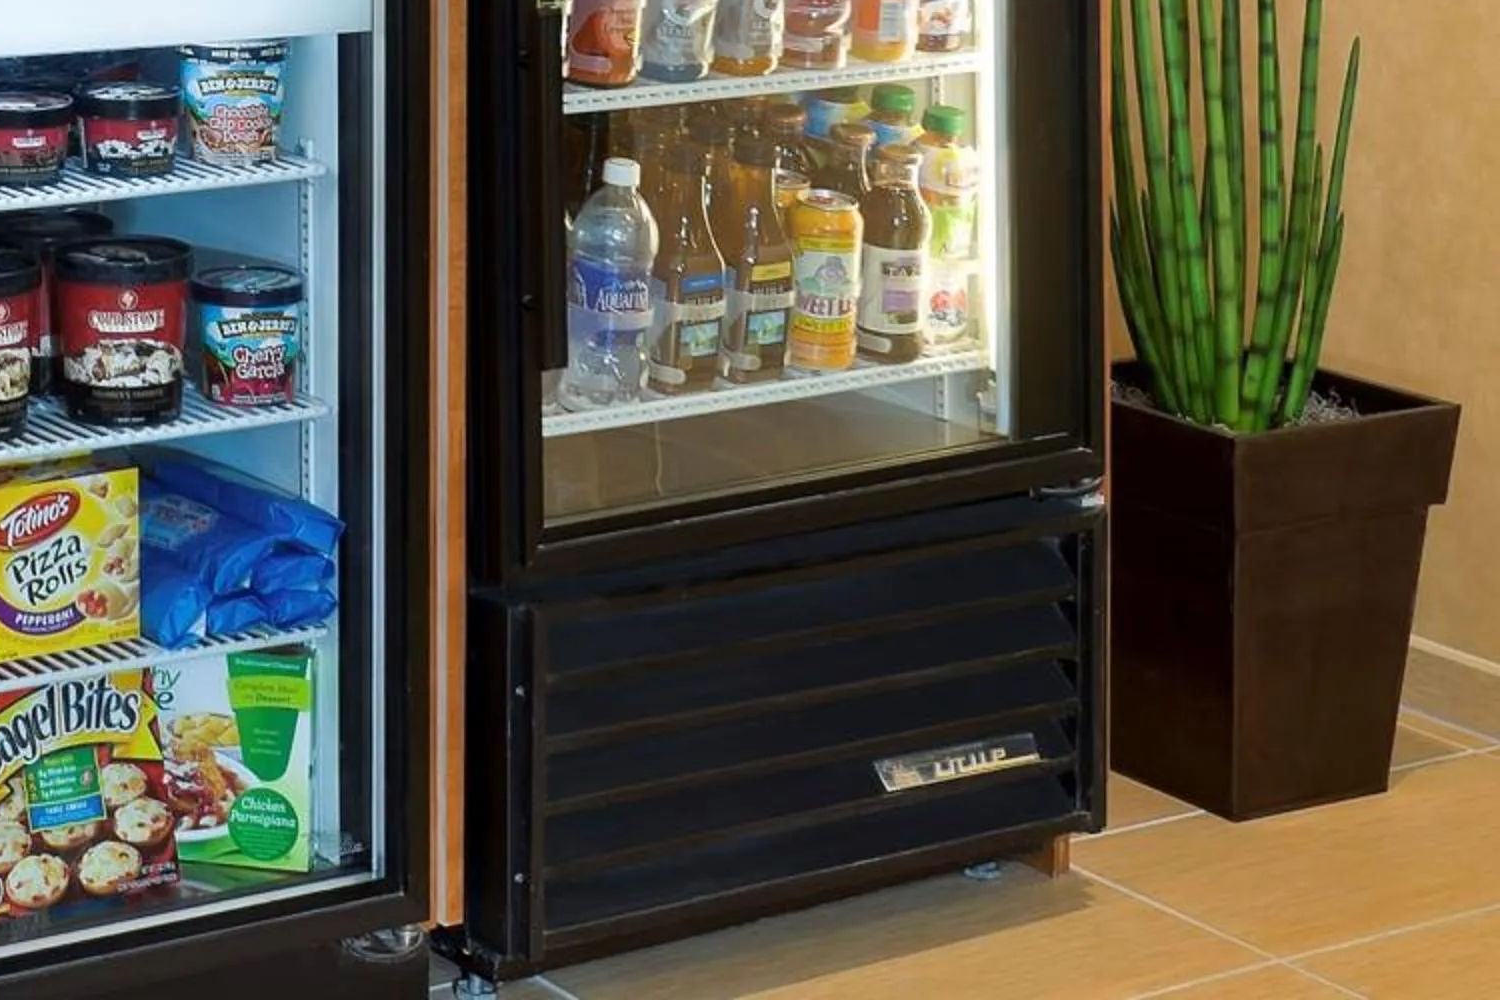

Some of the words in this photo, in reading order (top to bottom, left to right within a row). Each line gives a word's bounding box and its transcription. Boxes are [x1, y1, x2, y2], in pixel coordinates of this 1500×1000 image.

[233, 345, 286, 363] Cherry
[235, 362, 285, 380] Garcia
[0, 494, 69, 547] Totino's
[5, 535, 83, 585] Pizza
[19, 557, 88, 606] Rolls
[14, 608, 76, 626] PEPPERONI
[60, 673, 139, 733] Bites
[241, 797, 286, 812] Chicken
[230, 810, 296, 828] Parmigiana
